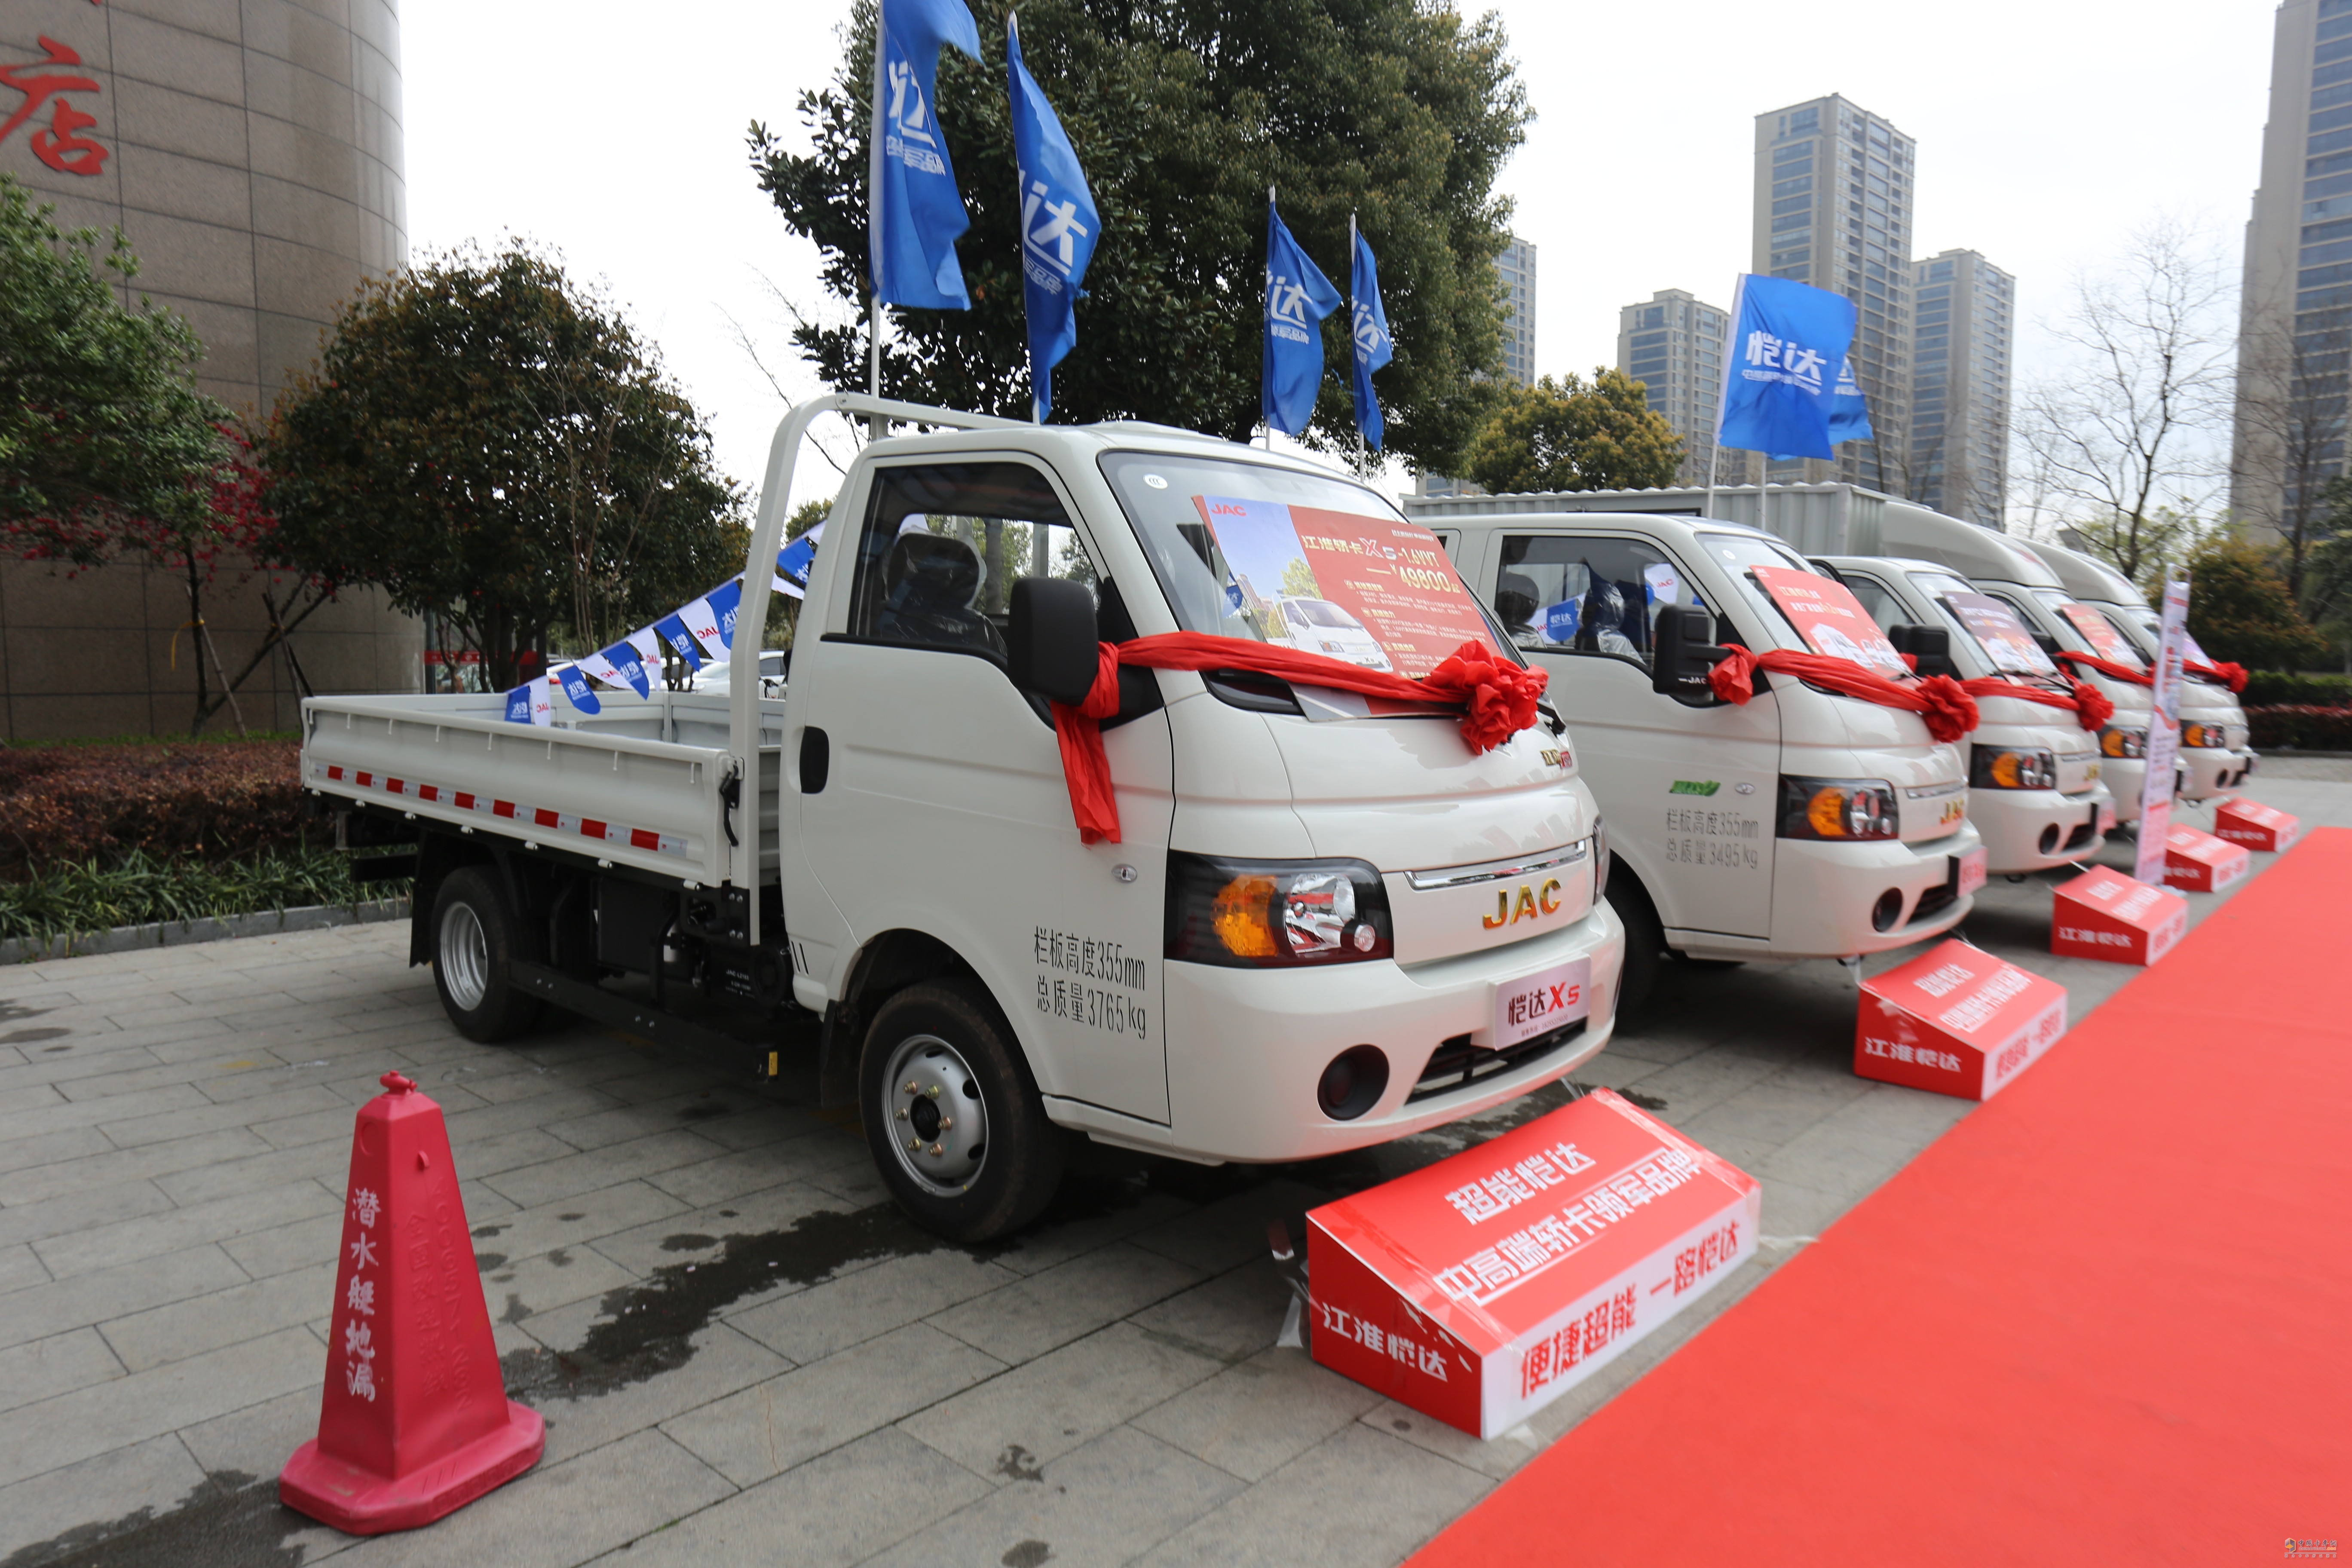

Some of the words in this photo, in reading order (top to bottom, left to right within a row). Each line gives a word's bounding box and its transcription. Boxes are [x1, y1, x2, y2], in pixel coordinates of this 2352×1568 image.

[0, 35, 110, 176] 店
[1019, 168, 1088, 276] 达
[1266, 271, 1314, 331] 达
[1746, 330, 1828, 386] 恺达
[1211, 503, 1247, 516] JAC
[1667, 807, 1759, 839] 栏板高度355mm
[1483, 877, 1562, 931] JAC
[1034, 925, 1145, 991] 栏板高度355mm
[1037, 974, 1146, 1040] 总质量3765kg
[1865, 1036, 1962, 1073] 江淮恺达
[1444, 1141, 1596, 1225] 超能恺达
[1432, 1148, 1702, 1306] 中高端轿卡领军品牌
[345, 1188, 381, 1403] 潜水艇地漏
[1521, 1283, 1637, 1400] 便捷超能
[1649, 1221, 1739, 1297] 一路恺达
[1322, 1302, 1449, 1383] 江淮恺达
